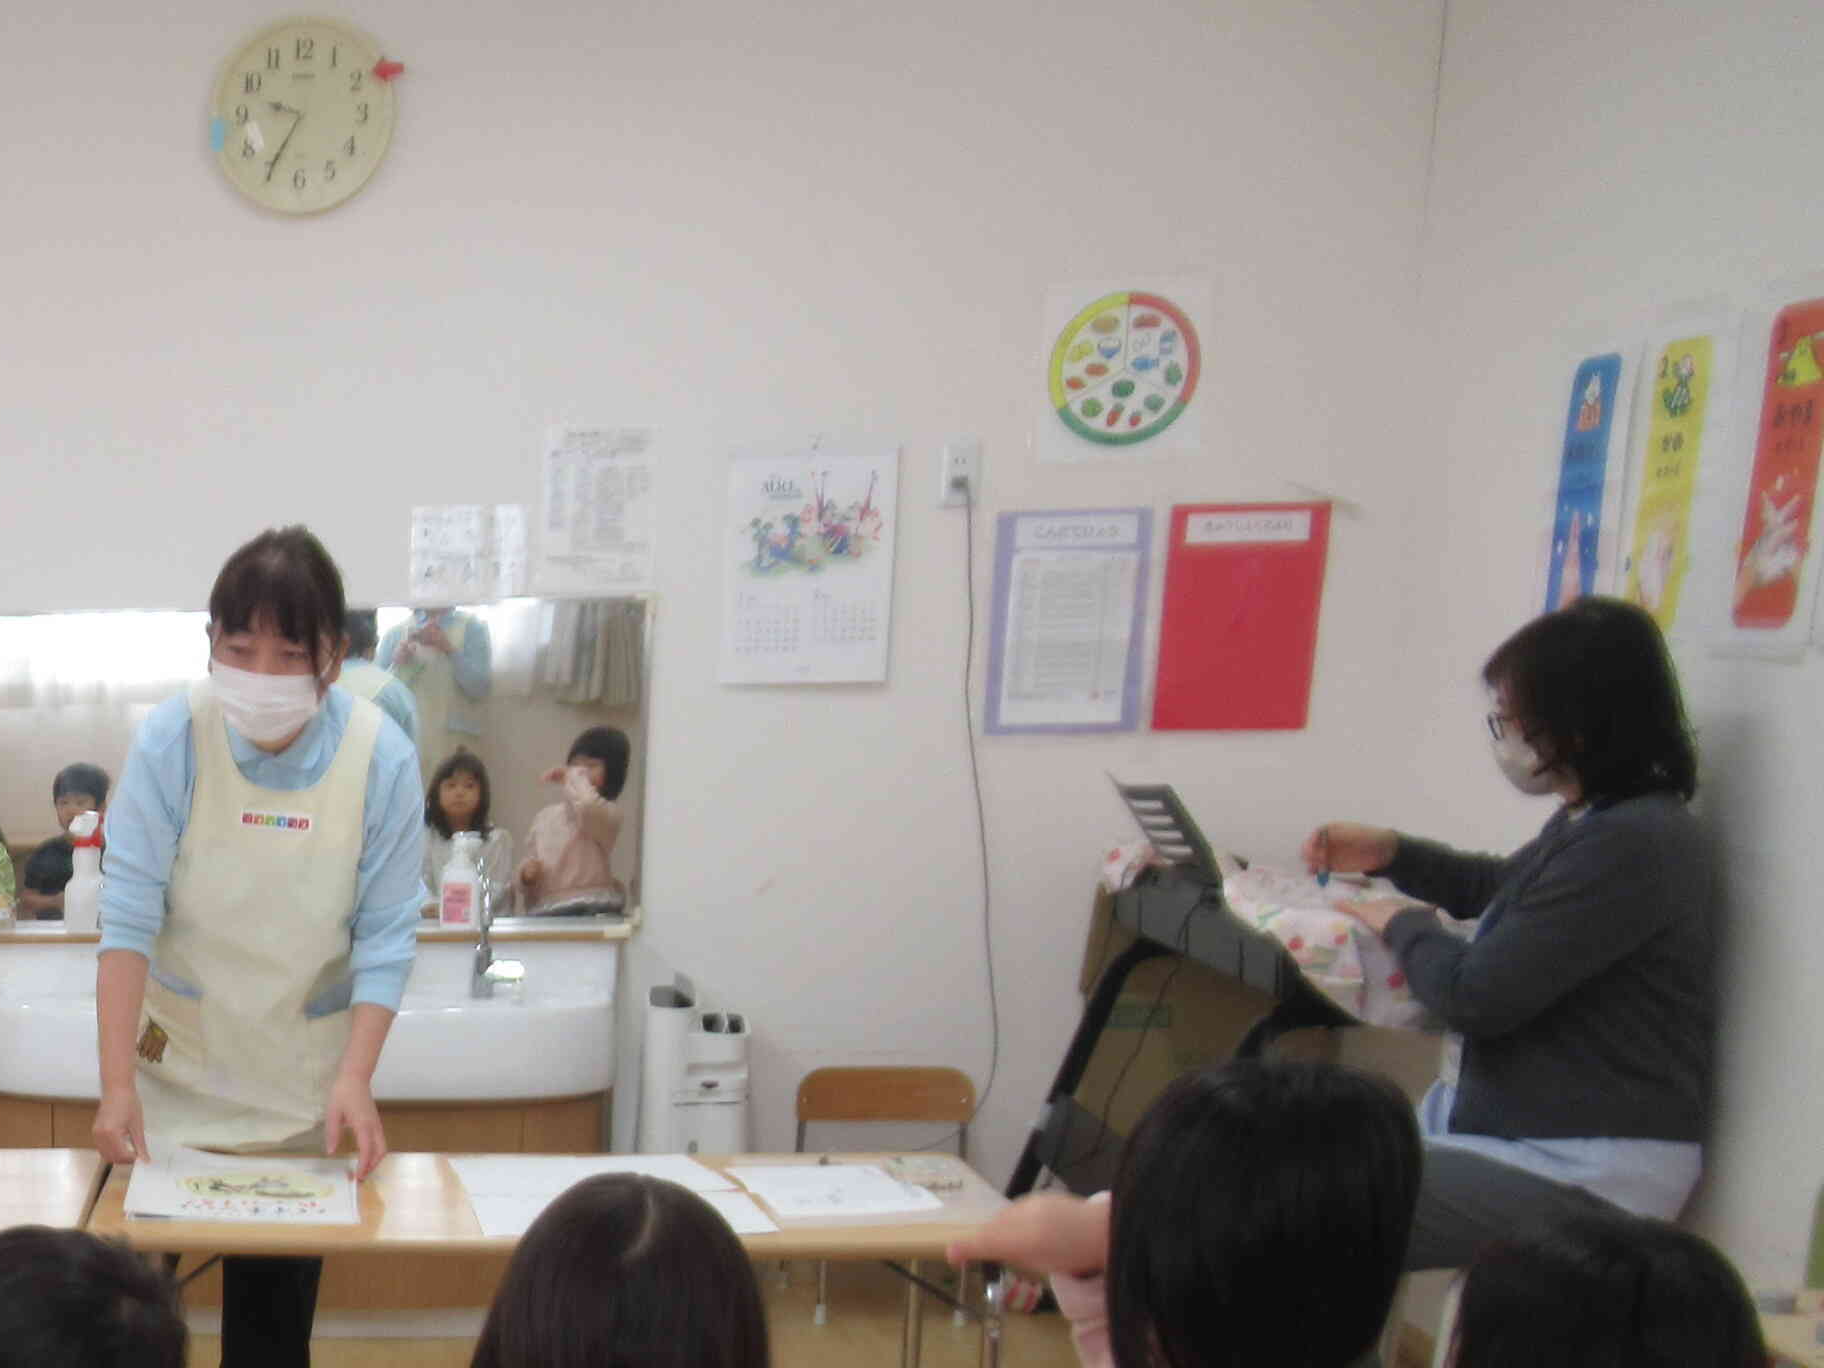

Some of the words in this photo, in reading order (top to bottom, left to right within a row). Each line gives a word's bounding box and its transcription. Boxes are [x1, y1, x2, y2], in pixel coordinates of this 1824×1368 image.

[267, 48, 280, 70] 11
[295, 38, 314, 60] 12
[330, 46, 337, 68] 1
[244, 72, 262, 93] 10
[349, 71, 362, 91] 2
[235, 105, 248, 125] 9
[355, 103, 368, 124] 3
[344, 136, 355, 157] 4
[293, 169, 306, 190] 6
[324, 161, 336, 181] 5
